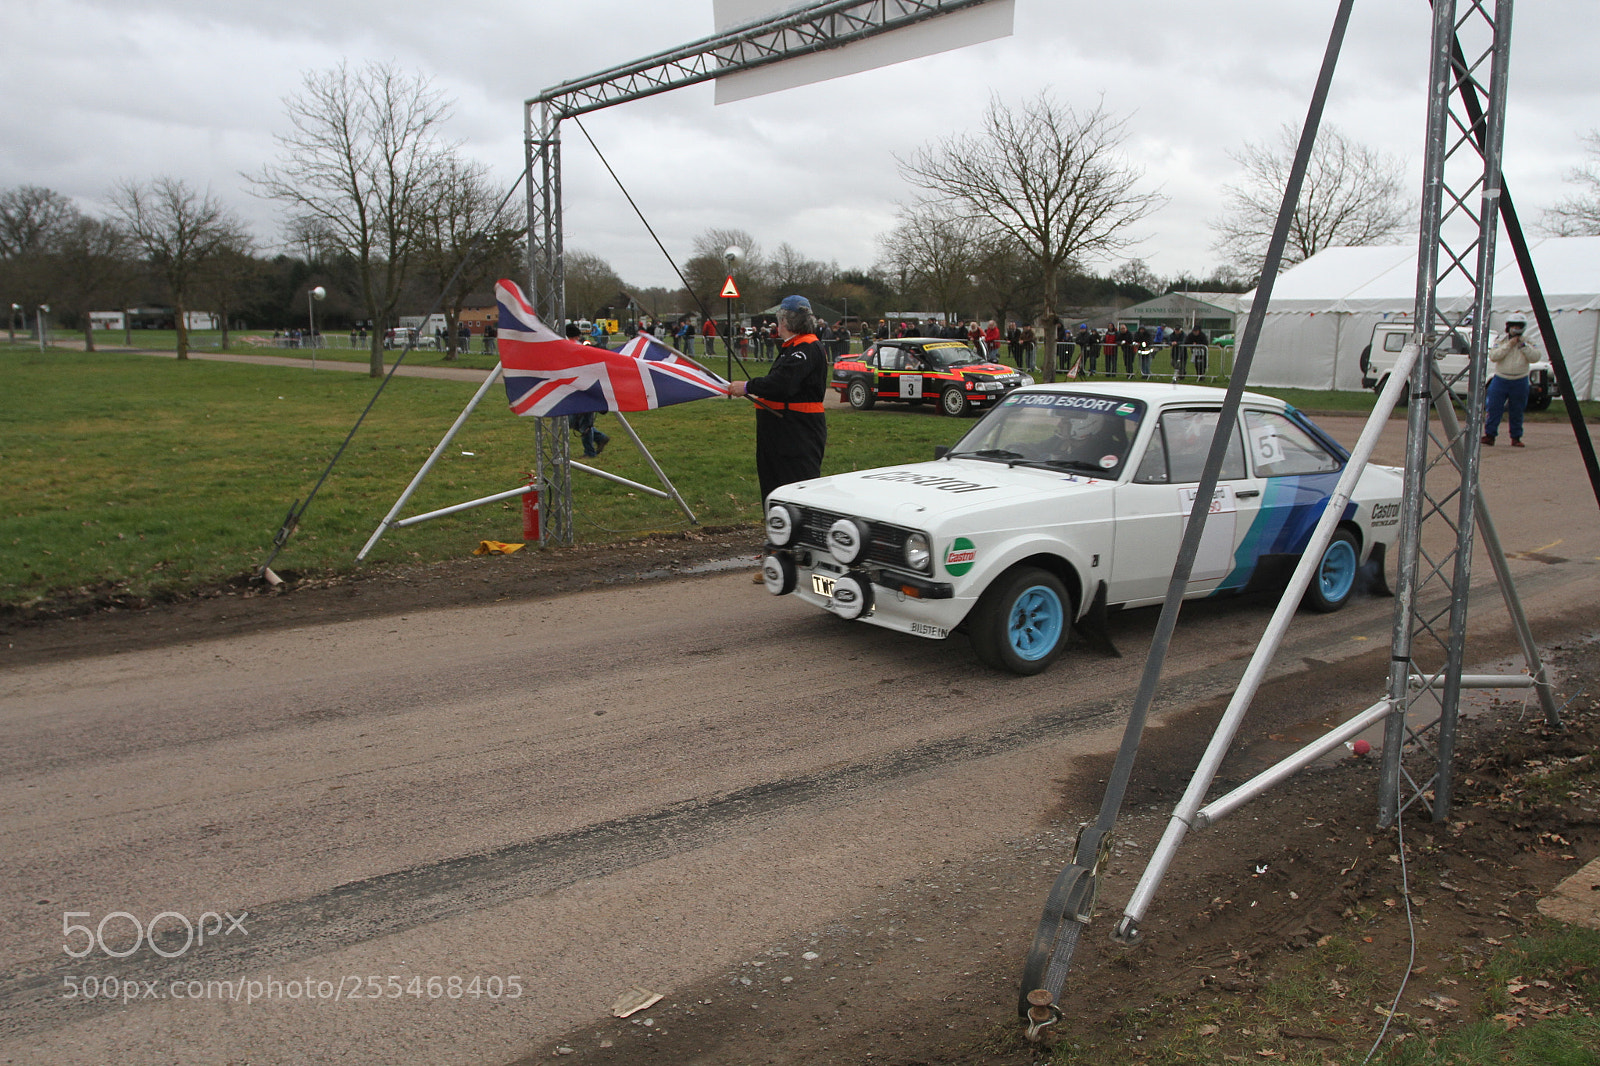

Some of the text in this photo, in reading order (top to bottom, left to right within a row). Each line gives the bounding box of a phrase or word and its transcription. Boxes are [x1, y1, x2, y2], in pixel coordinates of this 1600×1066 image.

[908, 383, 914, 396] 3
[1016, 395, 1118, 411] FORD ESCORT
[1371, 502, 1401, 520] Castrol
[948, 550, 977, 563] Castrol
[911, 622, 948, 638] BILSTEIN
